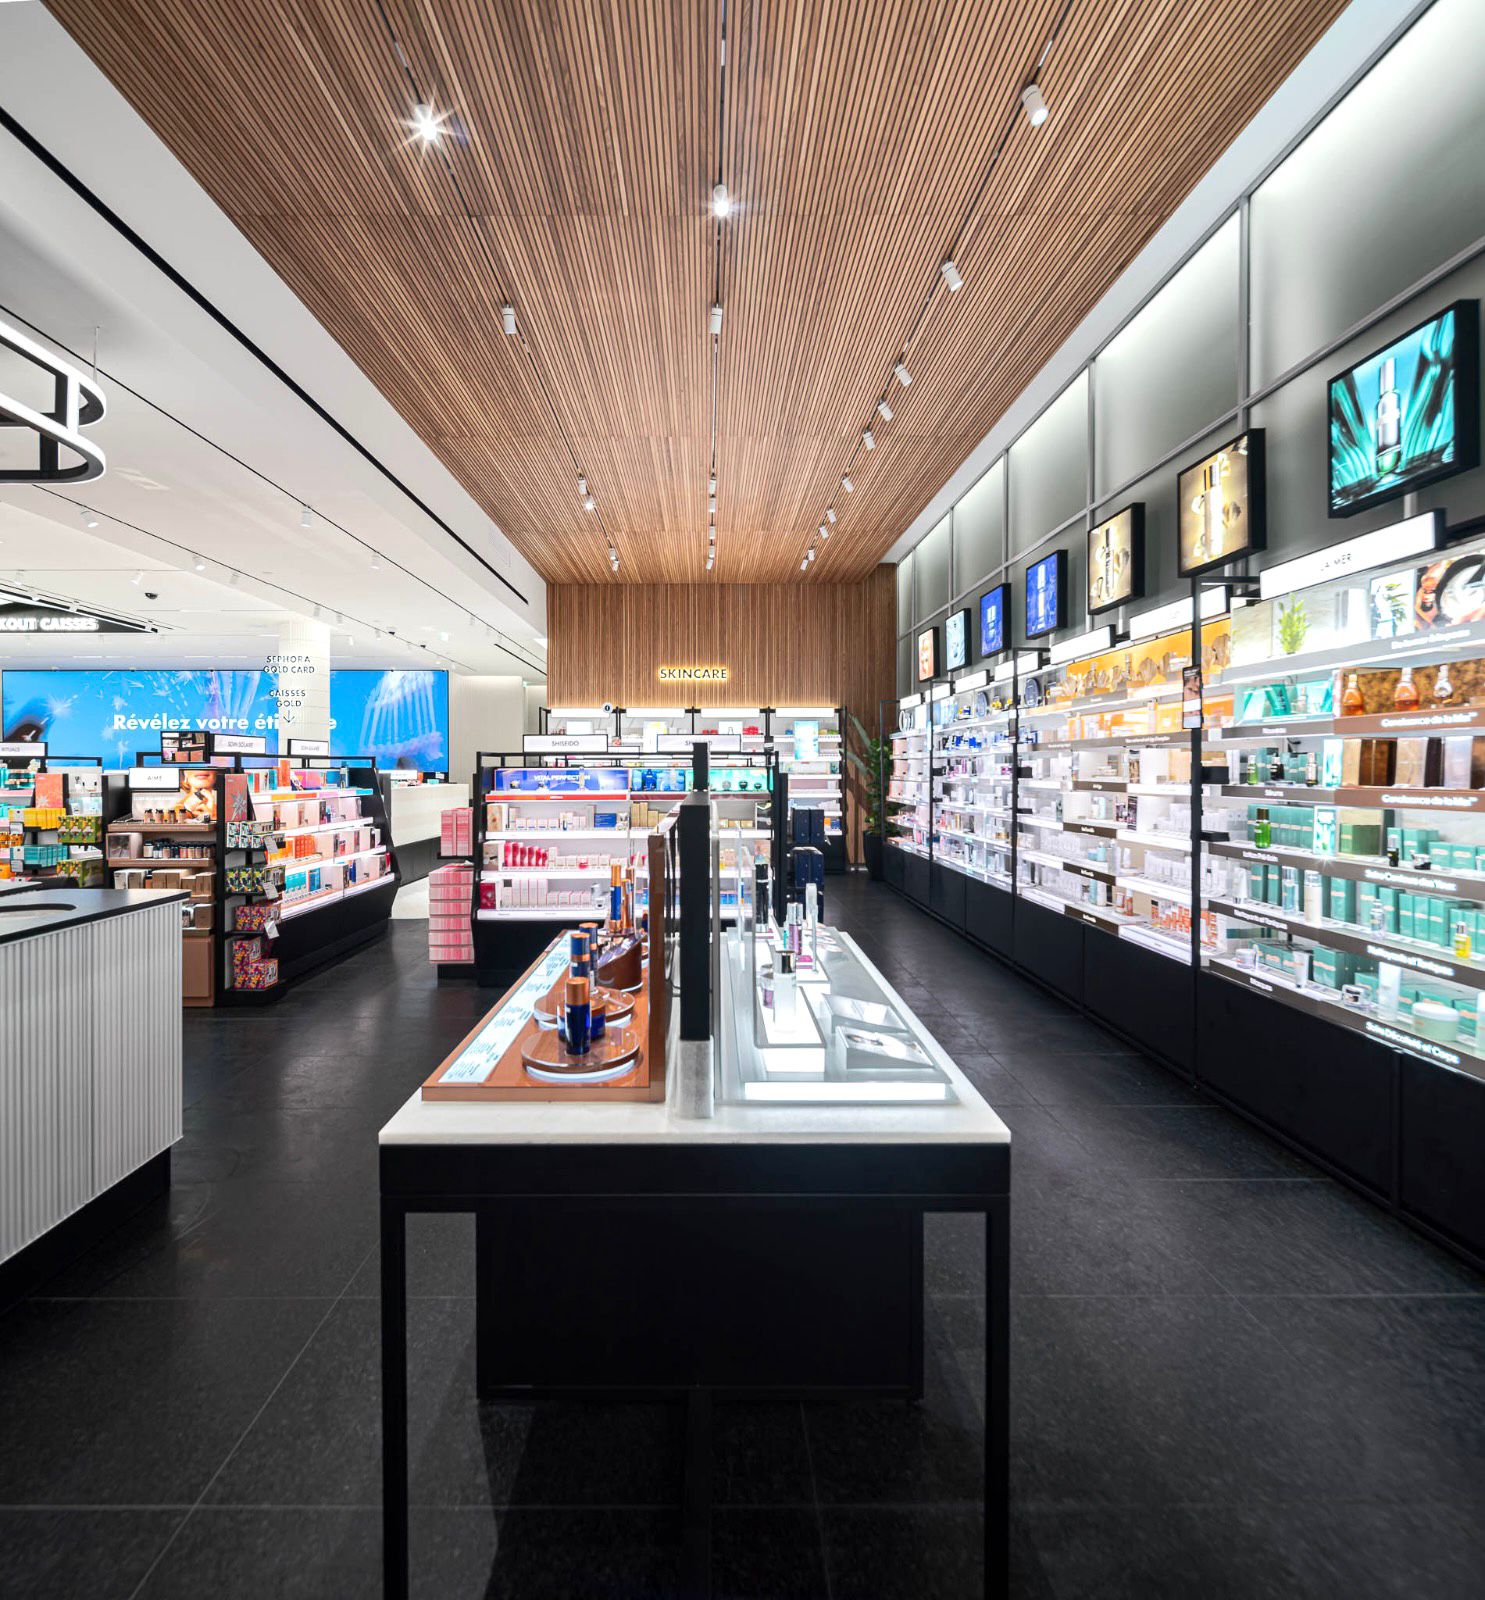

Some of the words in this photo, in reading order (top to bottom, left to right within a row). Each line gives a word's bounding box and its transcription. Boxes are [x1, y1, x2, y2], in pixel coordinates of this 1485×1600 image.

[40, 617, 99, 631] CAISSES
[266, 655, 311, 663] SEPHORA
[263, 665, 288, 674] GOLD
[291, 666, 315, 674] CARD
[660, 668, 727, 679] SKINCARE
[268, 689, 306, 697] CAISSES
[276, 700, 302, 708] GOLD
[113, 713, 191, 730] Révélez
[196, 714, 249, 730] votre
